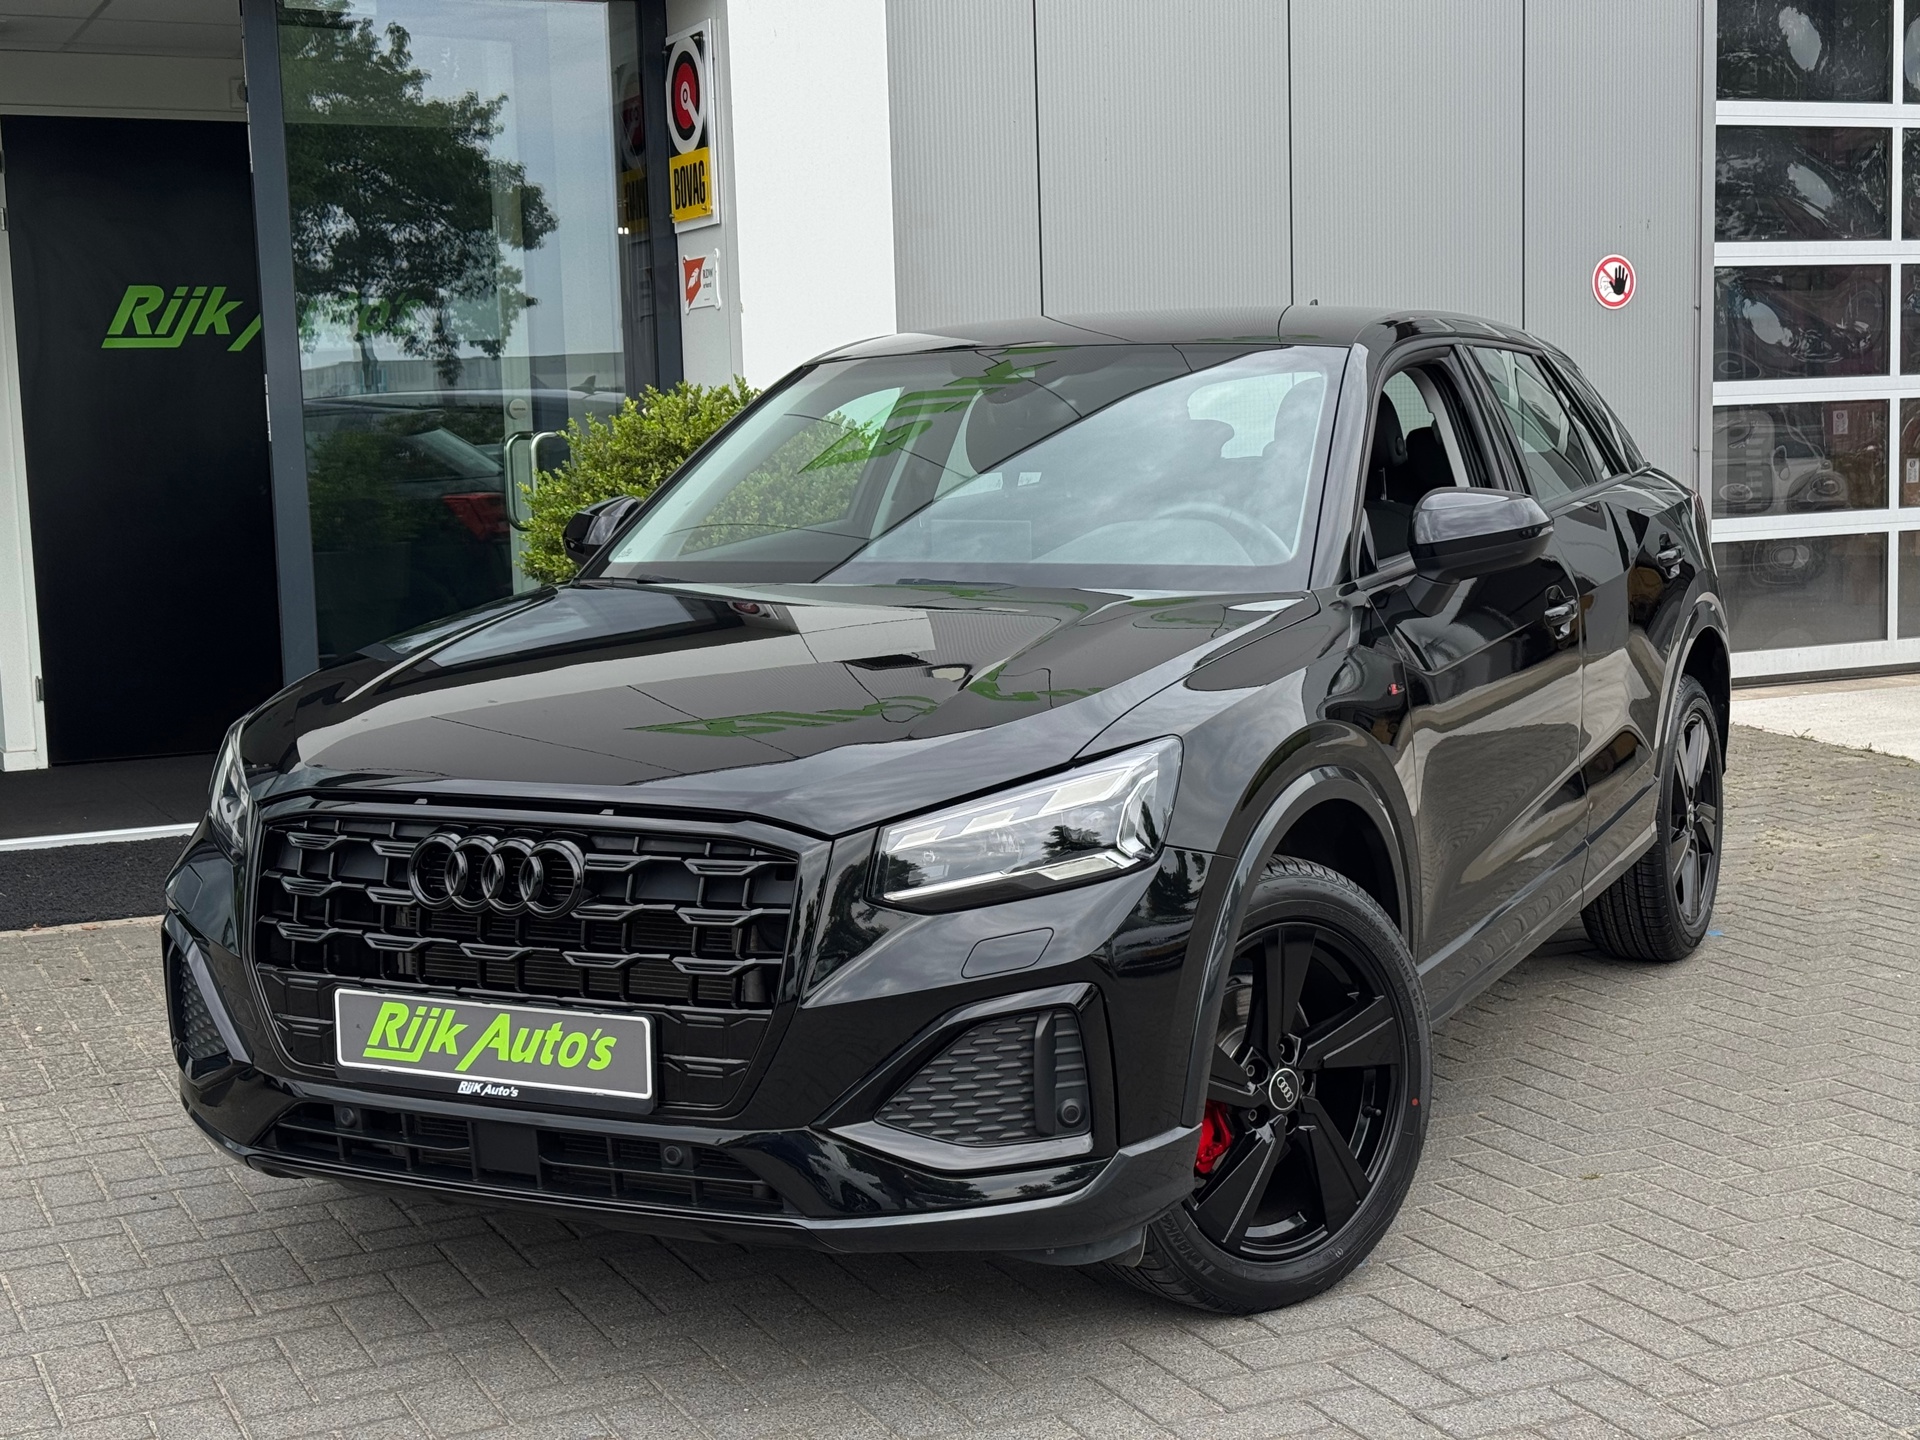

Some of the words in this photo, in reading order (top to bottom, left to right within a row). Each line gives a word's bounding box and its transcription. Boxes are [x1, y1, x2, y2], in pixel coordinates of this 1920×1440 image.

[674, 160, 706, 210] BOVAG
[101, 285, 244, 348] Rijk
[363, 1001, 469, 1063] Rijk
[454, 1012, 617, 1072] Auto's
[480, 1084, 519, 1097] Auto's
